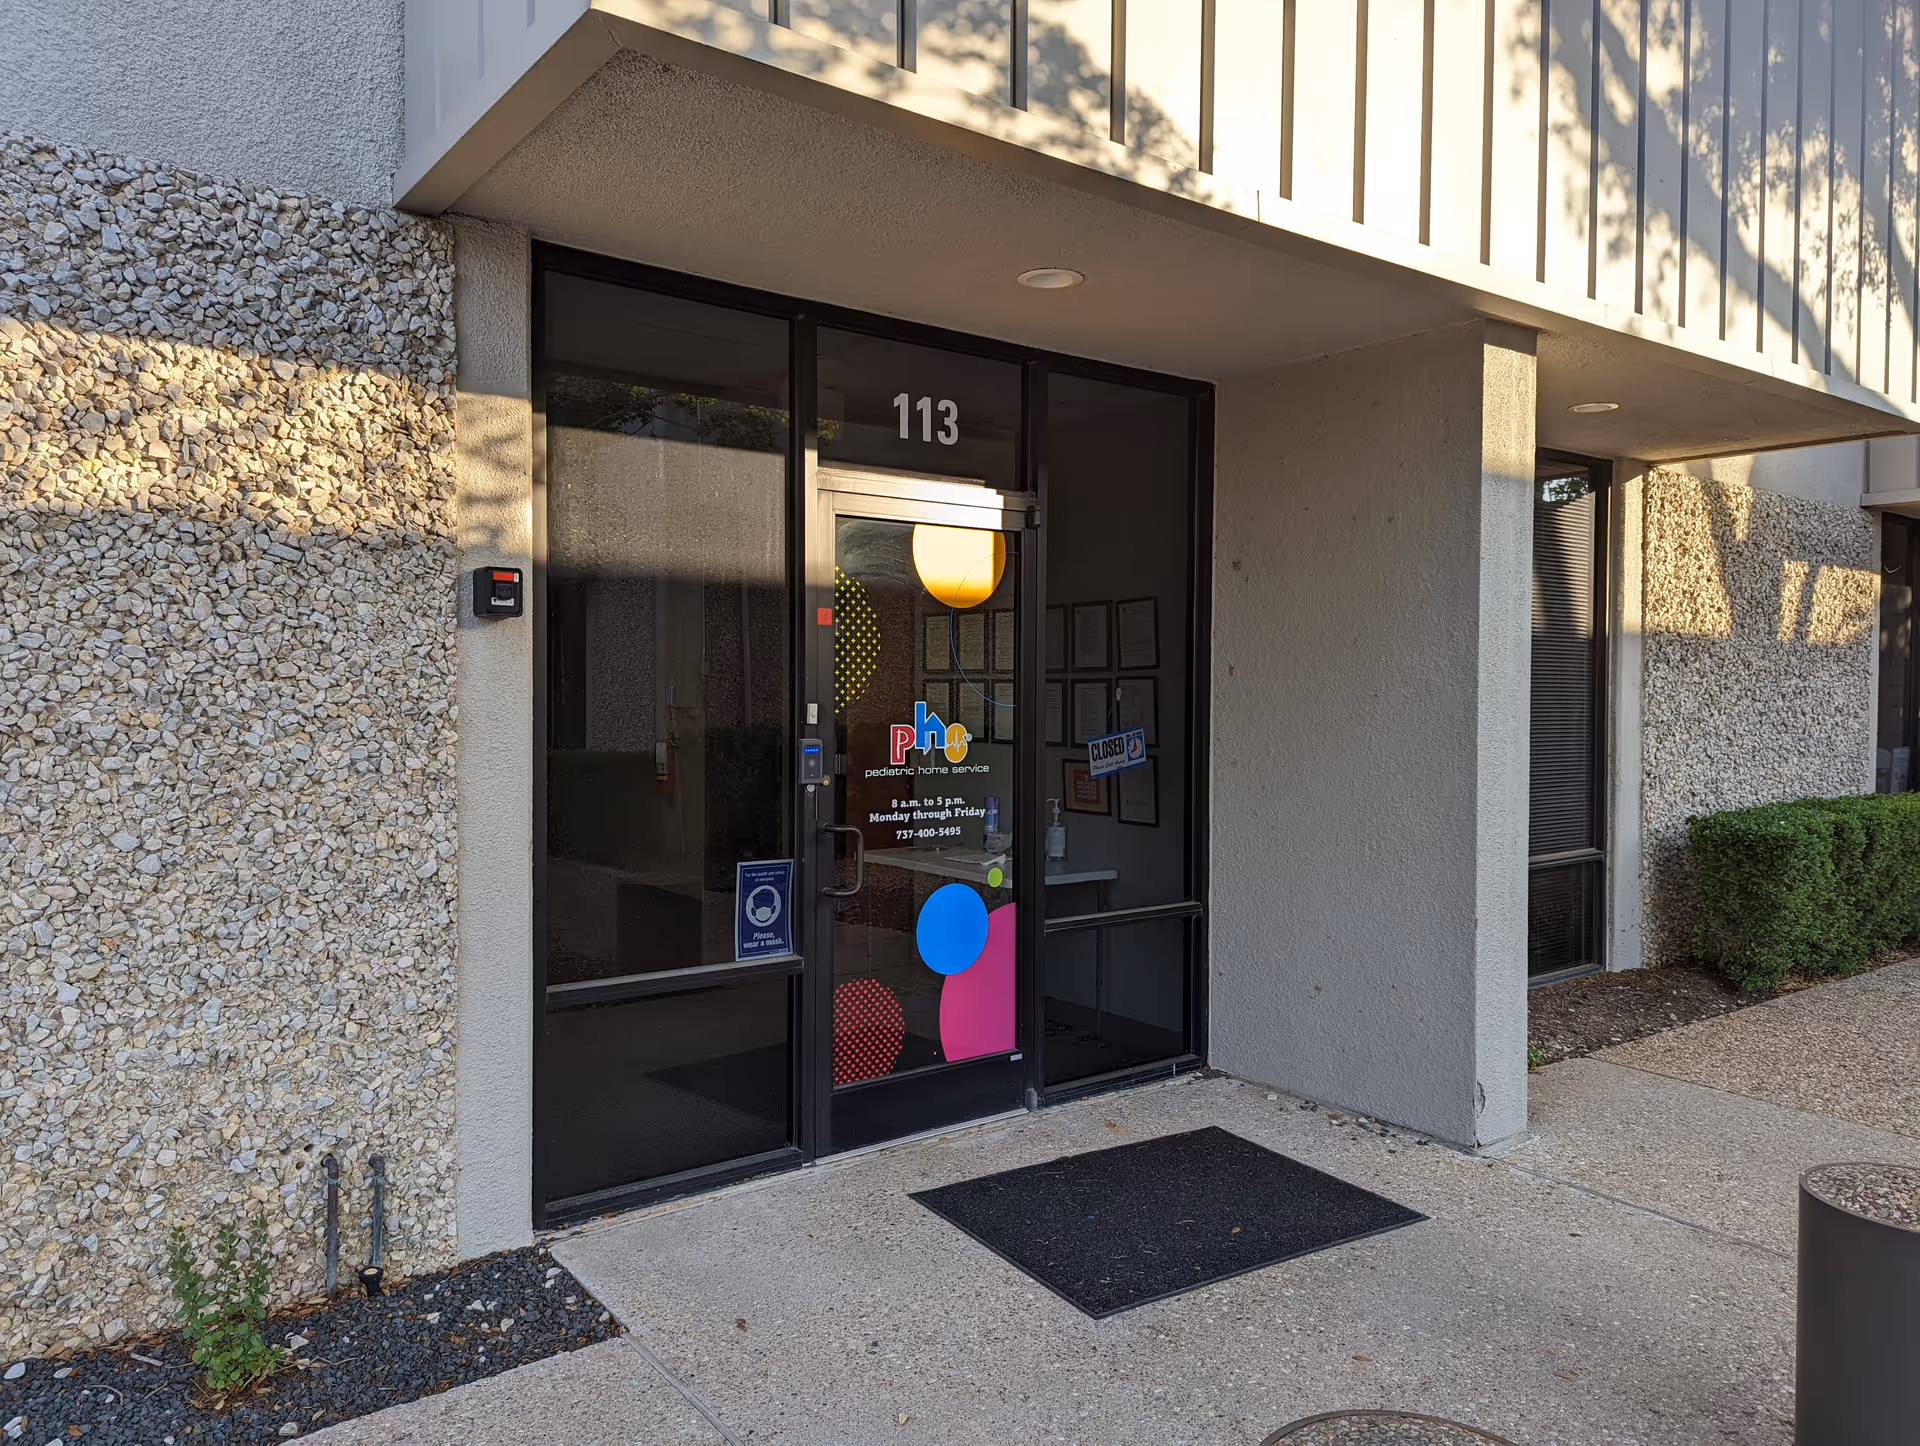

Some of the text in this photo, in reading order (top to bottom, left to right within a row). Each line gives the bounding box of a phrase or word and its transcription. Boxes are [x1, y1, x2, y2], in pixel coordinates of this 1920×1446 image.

[893, 392, 959, 446] 113
[1091, 737, 1125, 762] CLOSED
[865, 763, 990, 778] pediatric home service
[891, 796, 966, 808] 8 a.m. to 5 p.m.
[869, 812, 910, 823] Monday
[912, 808, 952, 820] through
[954, 807, 986, 817] Friday
[896, 826, 961, 840] 737-400-5495
[753, 932, 775, 940] Please,
[766, 937, 785, 946] mask.
